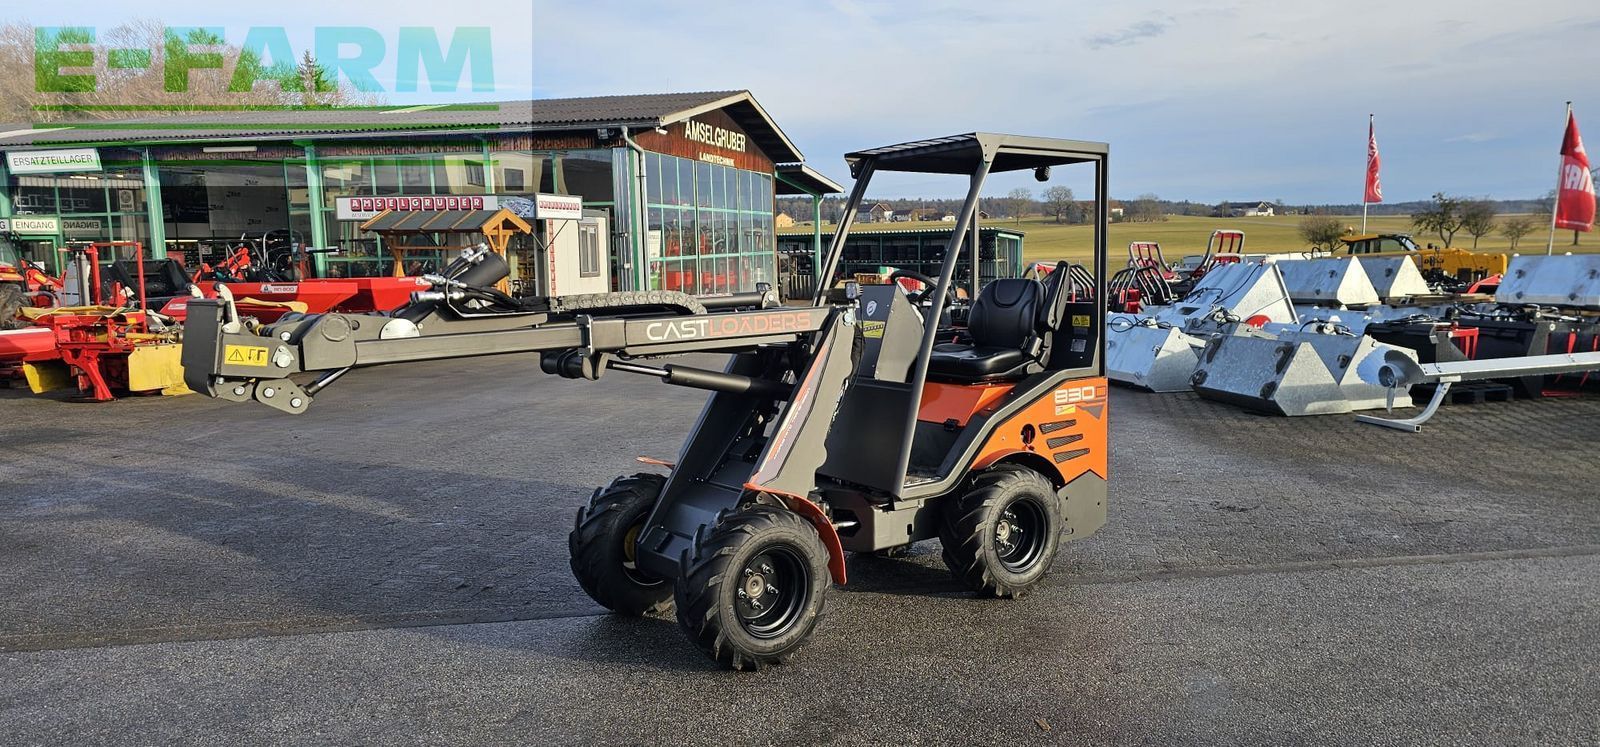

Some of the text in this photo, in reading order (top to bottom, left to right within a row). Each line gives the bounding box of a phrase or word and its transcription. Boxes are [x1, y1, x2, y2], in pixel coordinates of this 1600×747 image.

[685, 120, 746, 152] AMSELGRUBER
[13, 153, 94, 167] ERSATZTEILLAGER
[351, 197, 484, 211] AMSELGRUBER
[15, 221, 55, 230] EINGANG
